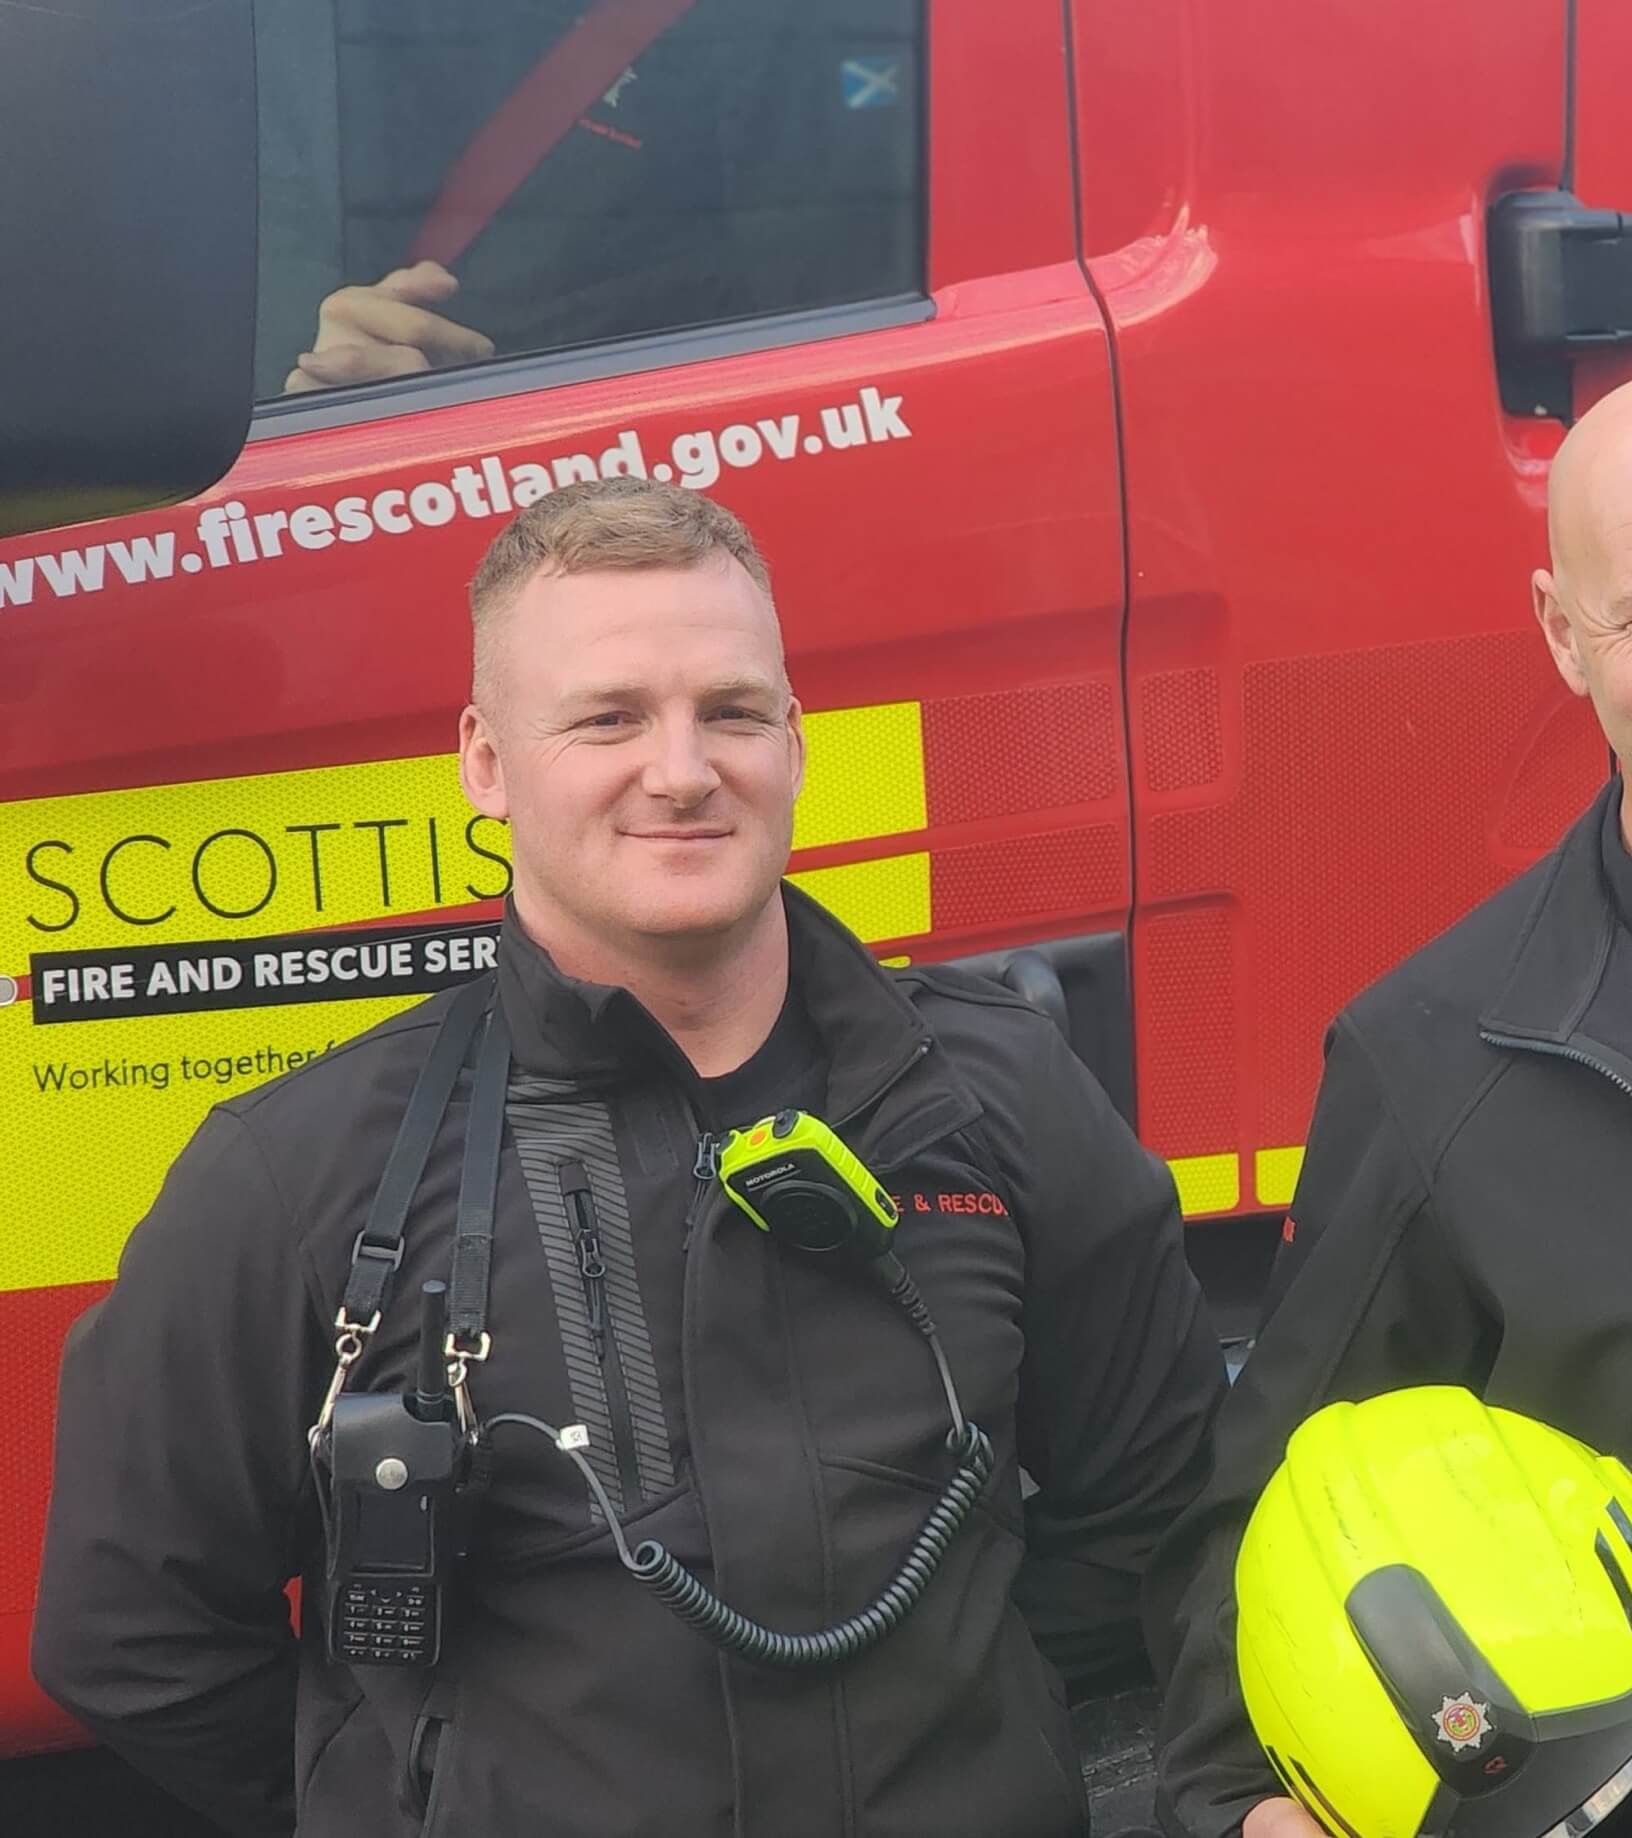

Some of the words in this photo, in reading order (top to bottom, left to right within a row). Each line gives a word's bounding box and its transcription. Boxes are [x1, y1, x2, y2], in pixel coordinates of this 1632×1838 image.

[26, 814, 513, 932] SCOTTIS
[42, 964, 136, 1005] FIRE
[146, 957, 242, 996] AND
[254, 943, 413, 988] RESCUE
[424, 934, 501, 974] SER
[33, 1058, 169, 1092] Working
[181, 1045, 316, 1084] together
[913, 1193, 931, 1212] &
[938, 1192, 1009, 1216] RESCU
